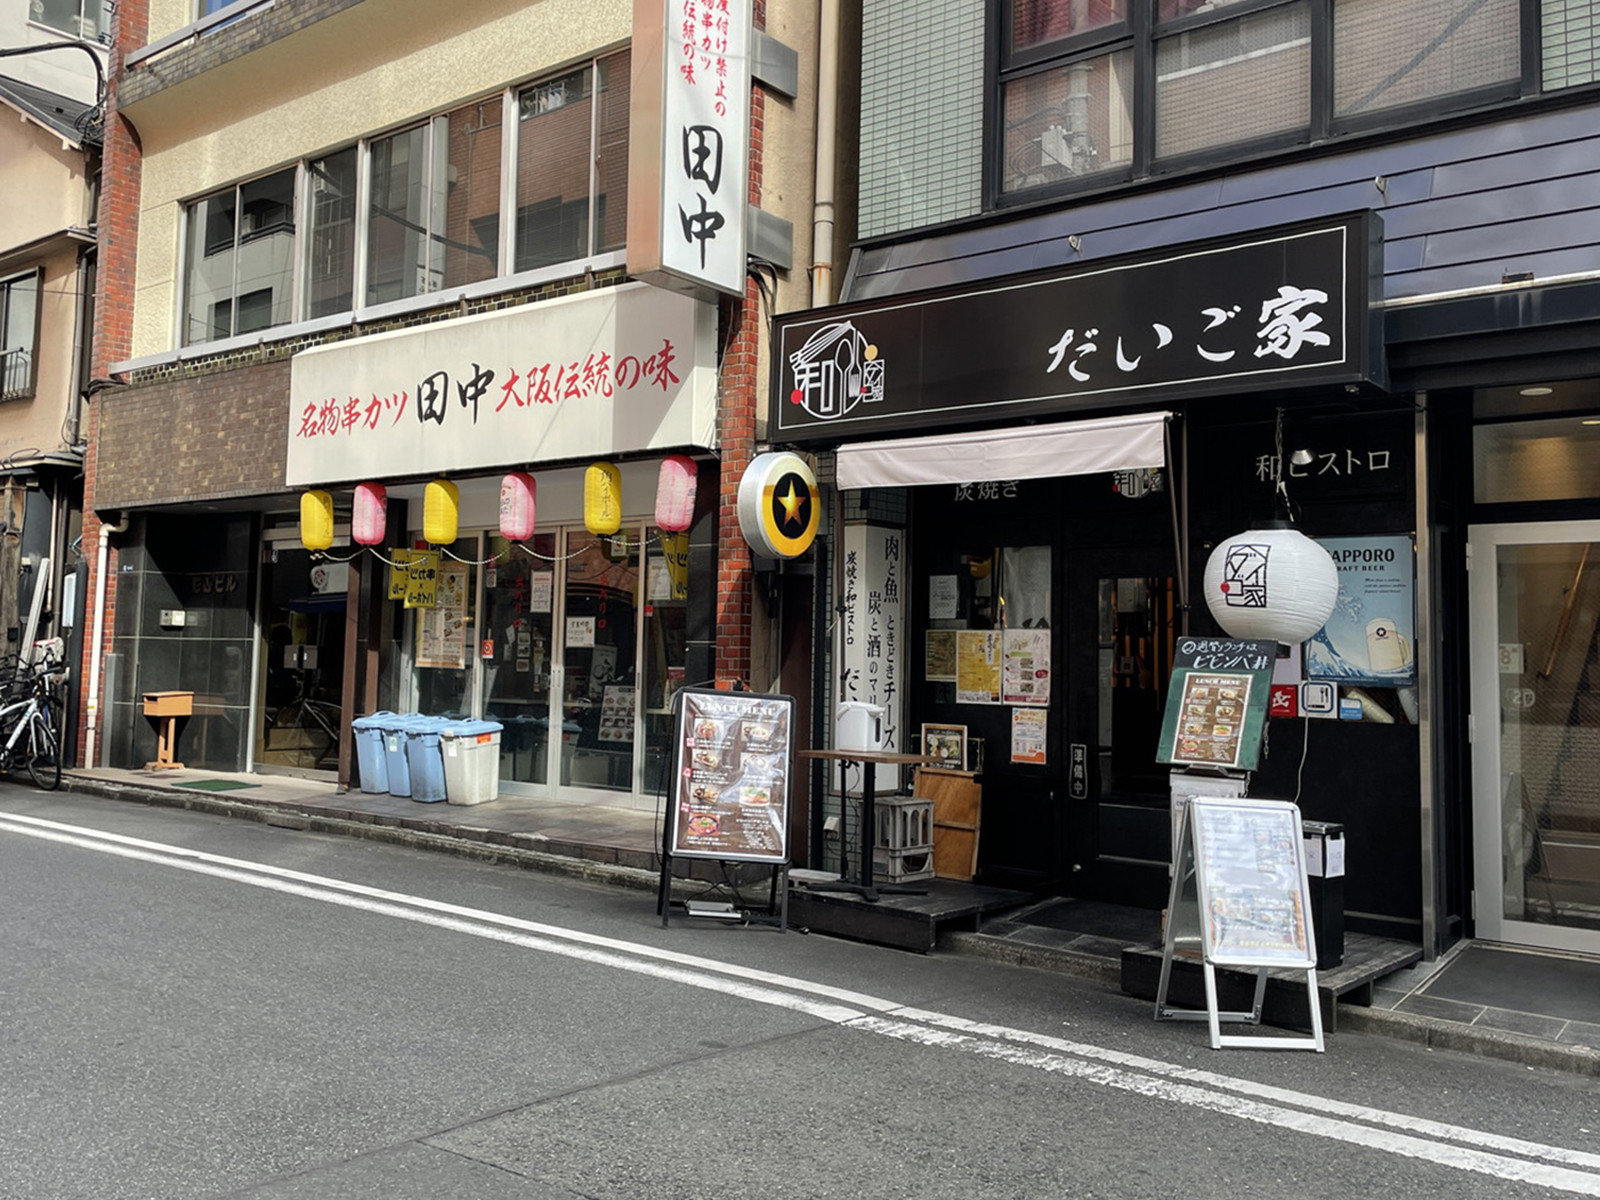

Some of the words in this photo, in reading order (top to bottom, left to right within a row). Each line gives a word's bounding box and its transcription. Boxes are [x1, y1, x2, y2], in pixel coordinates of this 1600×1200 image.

[677, 124, 726, 271] 田中
[1045, 284, 1331, 382] だいご家
[295, 391, 409, 439] 名物串カツ
[415, 362, 496, 427] 田中
[494, 338, 681, 413] 大阪伝統の味
[883, 535, 899, 604] 肉と魚
[1327, 547, 1395, 563] APPORO
[700, 702, 739, 712] LUNCH
[741, 705, 776, 716] MENU
[883, 615, 897, 749] ときどきチーズ
